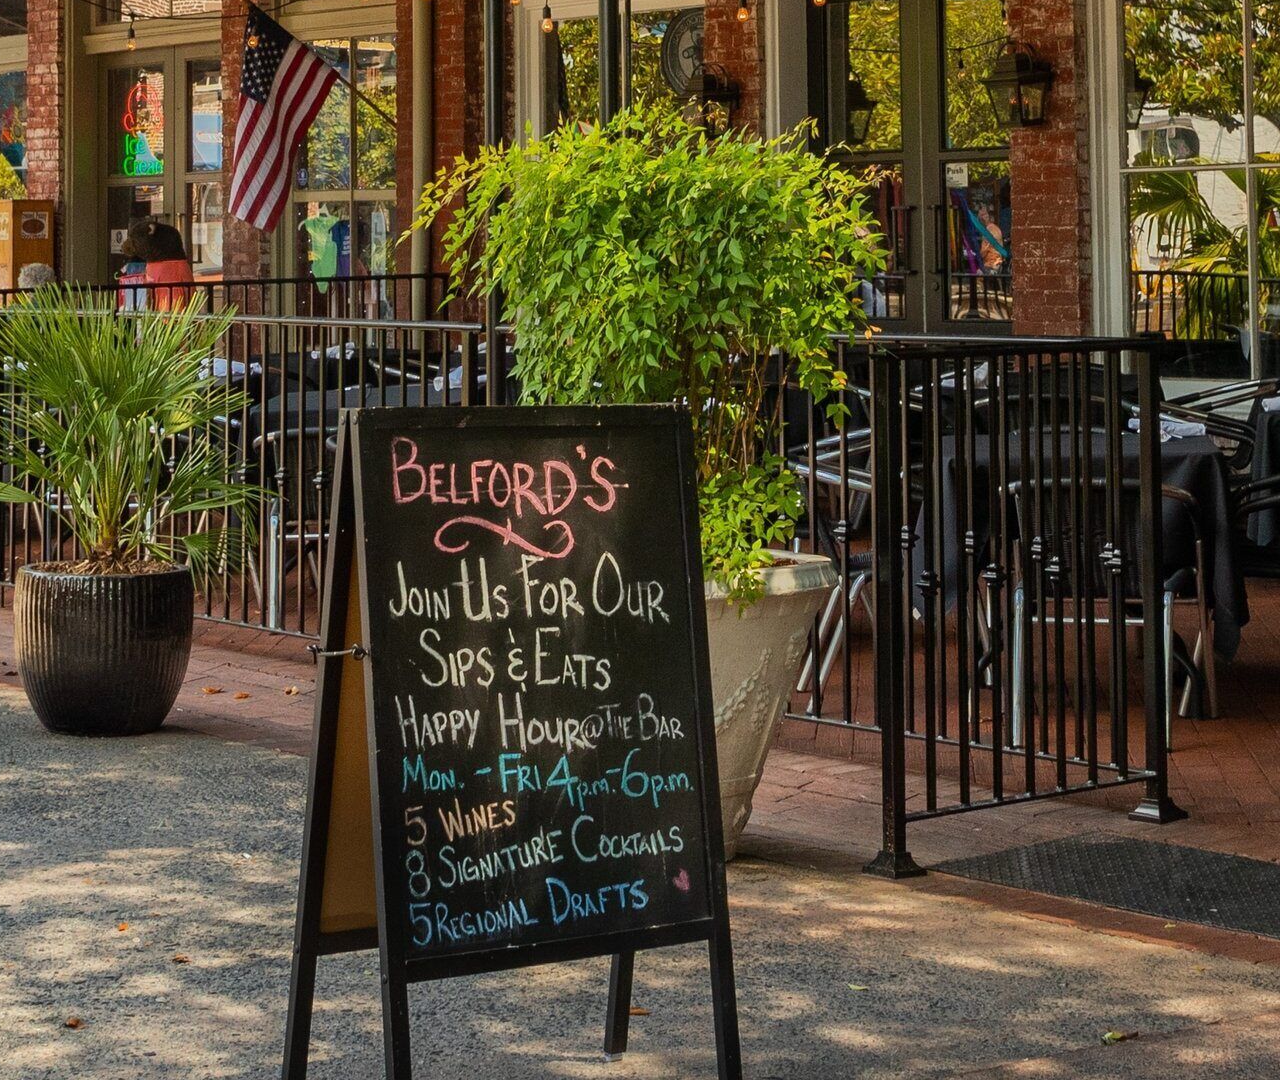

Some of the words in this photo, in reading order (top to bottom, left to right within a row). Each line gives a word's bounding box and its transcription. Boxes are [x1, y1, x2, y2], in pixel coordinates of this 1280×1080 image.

[125, 133, 146, 156] Ice
[947, 166, 964, 174] Push
[391, 436, 616, 518] BELFORD'S
[389, 561, 450, 621] JOIN
[453, 557, 509, 622] US
[515, 554, 585, 618] FOR
[593, 551, 670, 623] OUR
[420, 628, 494, 688] SIPS
[507, 628, 528, 693] &
[535, 627, 611, 691] EATS
[395, 695, 480, 750] HAPPY
[637, 693, 685, 742] BAR
[499, 752, 541, 794] FRI
[405, 806, 427, 847] 5
[405, 849, 430, 898] 8
[438, 824, 564, 888] SIGNATURE
[571, 815, 684, 863] COCKTAILS
[409, 902, 433, 946] 5
[435, 898, 538, 943] REGIONAL
[545, 877, 649, 925] DRAFTS
